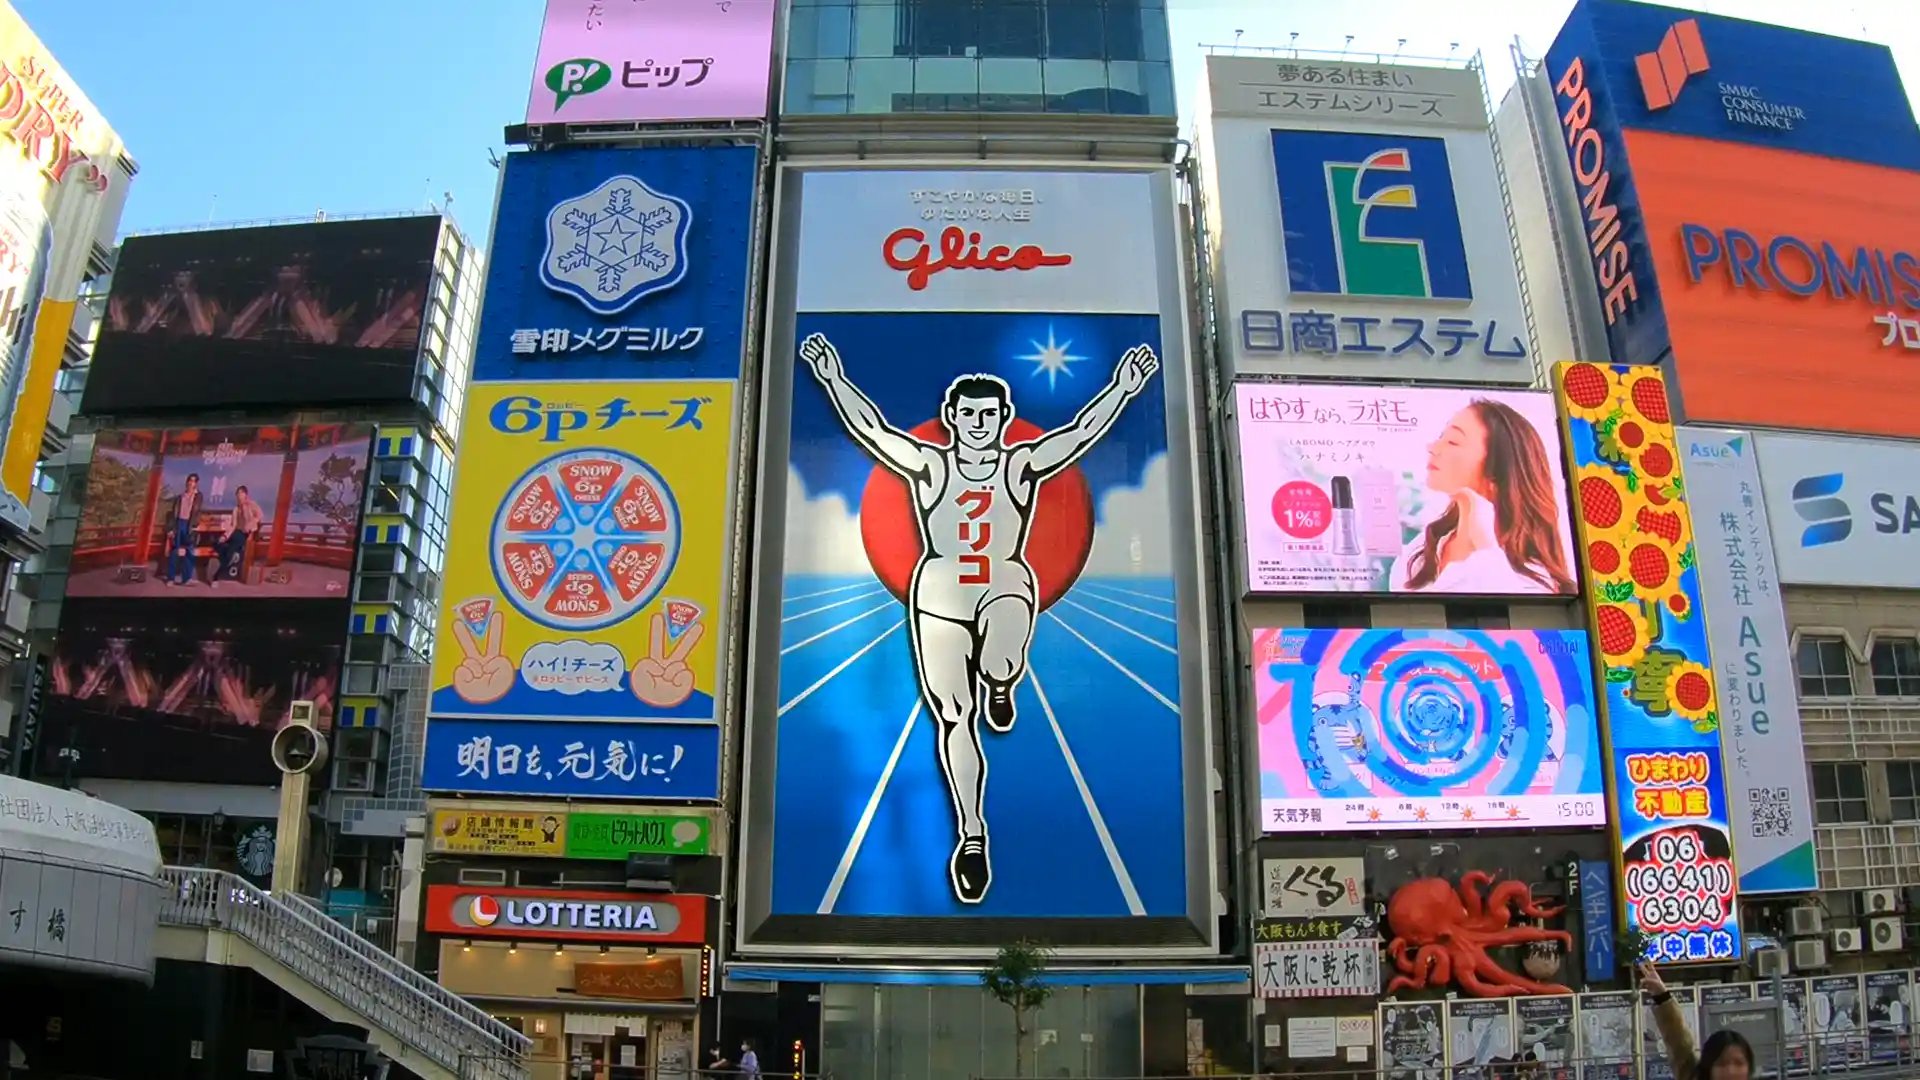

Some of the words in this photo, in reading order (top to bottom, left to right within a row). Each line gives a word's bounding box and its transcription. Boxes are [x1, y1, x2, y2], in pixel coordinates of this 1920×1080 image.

[621, 57, 714, 88] ピップ
[1277, 64, 1414, 88] 夢ある住まい
[1259, 90, 1443, 117] エステムシリーズ
[1718, 82, 1760, 99] SMBC
[1722, 95, 1806, 120] CONSUMER
[1726, 108, 1793, 130] FINANCE
[1557, 56, 1638, 326] PROMISE
[510, 326, 704, 353] 雪印メグミルク
[1241, 309, 1527, 358] 日商エステム
[1690, 442, 1730, 459] Asue
[569, 465, 613, 477] SNOW
[512, 483, 543, 523] SNOW
[635, 485, 662, 523] SNOW
[1283, 509, 1313, 528] 1%
[955, 486, 995, 583] グリコ
[506, 552, 534, 589] SNOW
[627, 552, 658, 593] SNOW
[554, 600, 601, 612] SNOW
[1720, 512, 1753, 606] 株式会社
[1738, 616, 1770, 735] Asue
[1627, 753, 1708, 784] ひまわり
[1273, 807, 1322, 823] 天気予報
[1635, 787, 1710, 819] 不動産
[1657, 836, 1696, 863] 06
[1283, 865, 1346, 908] くくる
[1568, 862, 1580, 896] 2F
[1628, 865, 1730, 897] (6641)
[507, 900, 658, 929] LOTTERIA
[1643, 895, 1721, 924] 6304
[1256, 920, 1342, 939] 大阪もんを食す
[1263, 950, 1361, 988] 大阪に乾杯
